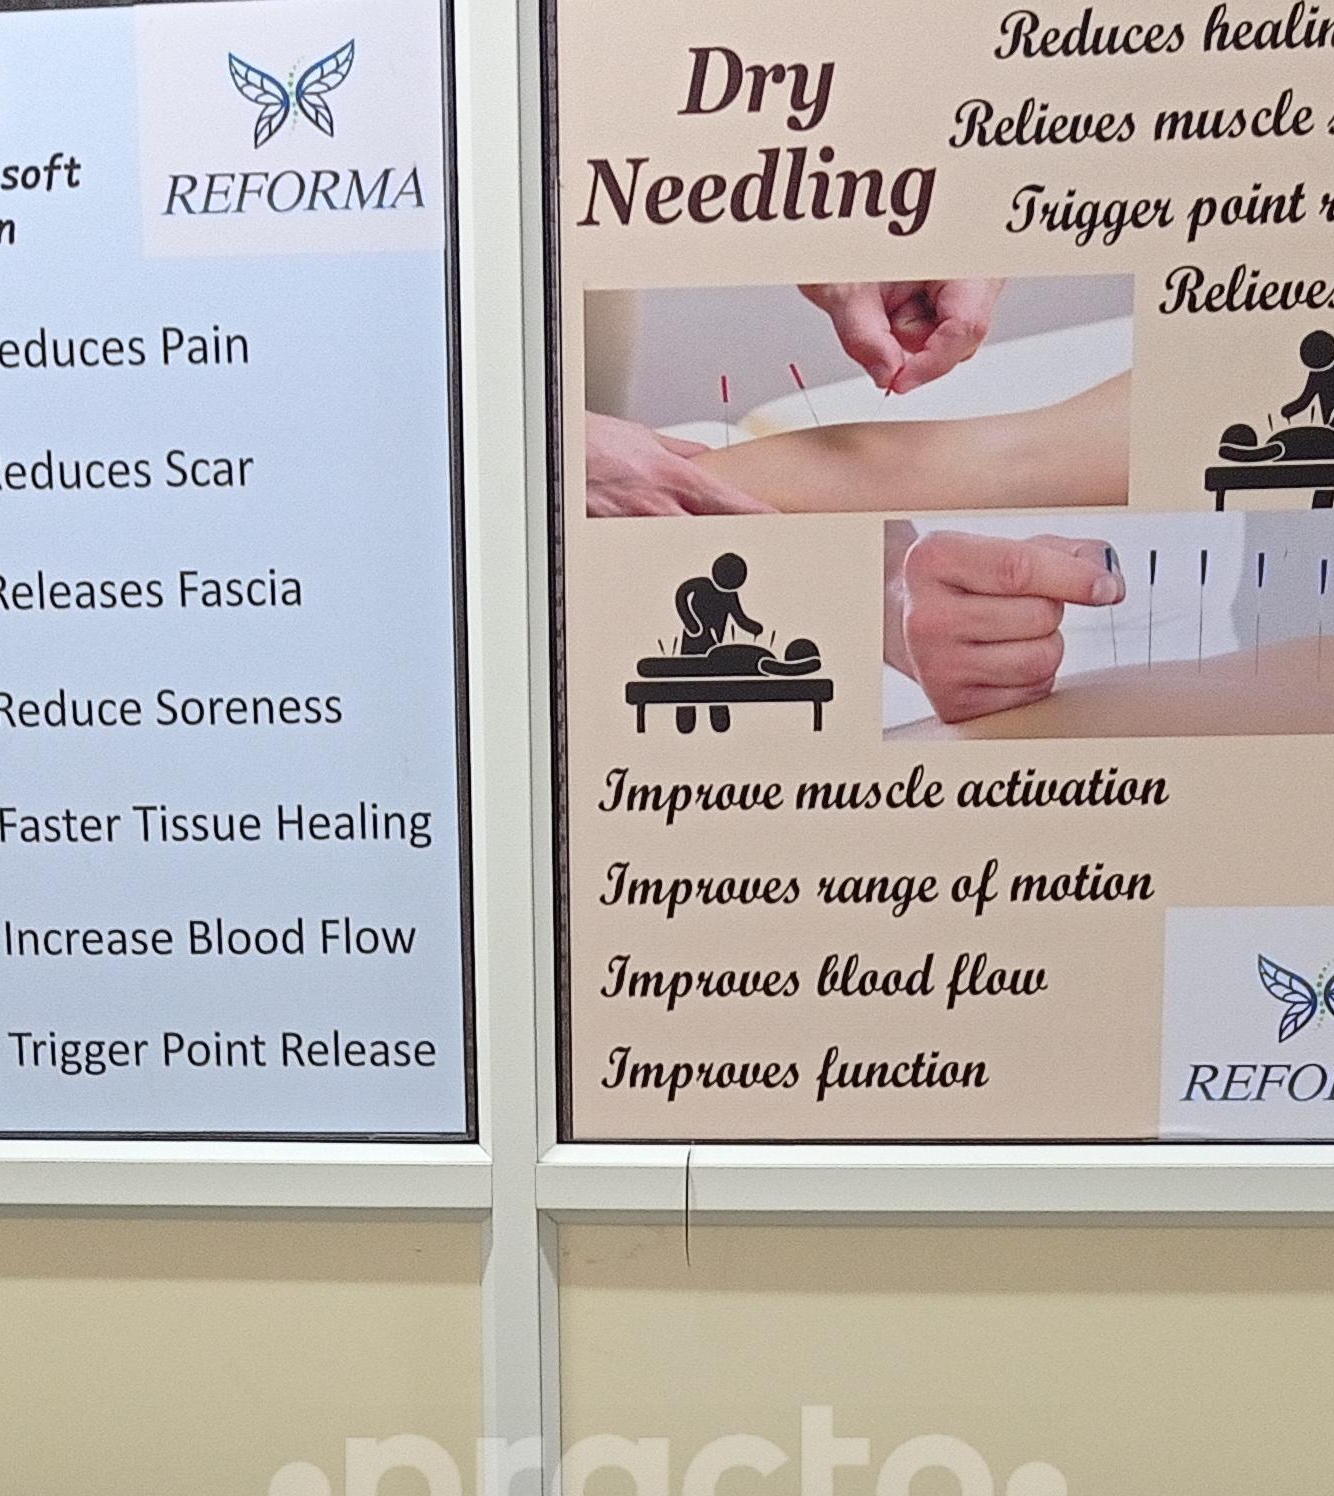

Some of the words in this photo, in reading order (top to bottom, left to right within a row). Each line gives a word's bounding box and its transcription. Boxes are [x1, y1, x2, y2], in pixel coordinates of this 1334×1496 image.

[994, 8, 1184, 59] Reduces
[678, 47, 834, 131] Dry
[949, 98, 1135, 148] Relieves
[1154, 88, 1314, 140] muscle
[1, 153, 81, 191] soft
[164, 167, 424, 215] REFORMA
[577, 146, 936, 236] Needling
[1006, 184, 1174, 247] Trigger
[1188, 183, 1306, 242] point
[163, 325, 248, 365] Pain
[167, 450, 253, 487] Scar
[180, 569, 301, 607] Fascia
[157, 689, 342, 725] Soreness
[599, 768, 783, 825] Improve
[796, 765, 944, 809] muscle
[957, 768, 1169, 807] activation
[0, 808, 120, 842] Faster
[133, 805, 260, 841] Tissue
[278, 802, 431, 848] Healing
[600, 862, 800, 919] Improves
[818, 877, 938, 917] range
[952, 859, 998, 916] of
[1011, 863, 1154, 901] motion
[6, 921, 172, 955] Increase
[190, 918, 303, 954] Blood
[322, 917, 415, 954] Flow
[601, 955, 799, 1011] Improves
[818, 953, 934, 996] blood
[947, 953, 1047, 1009] flow
[8, 1032, 148, 1075] Trigger
[164, 1032, 266, 1066] Point
[282, 1030, 435, 1066] Release
[602, 1047, 799, 1102] Improves
[817, 1046, 989, 1101] function
